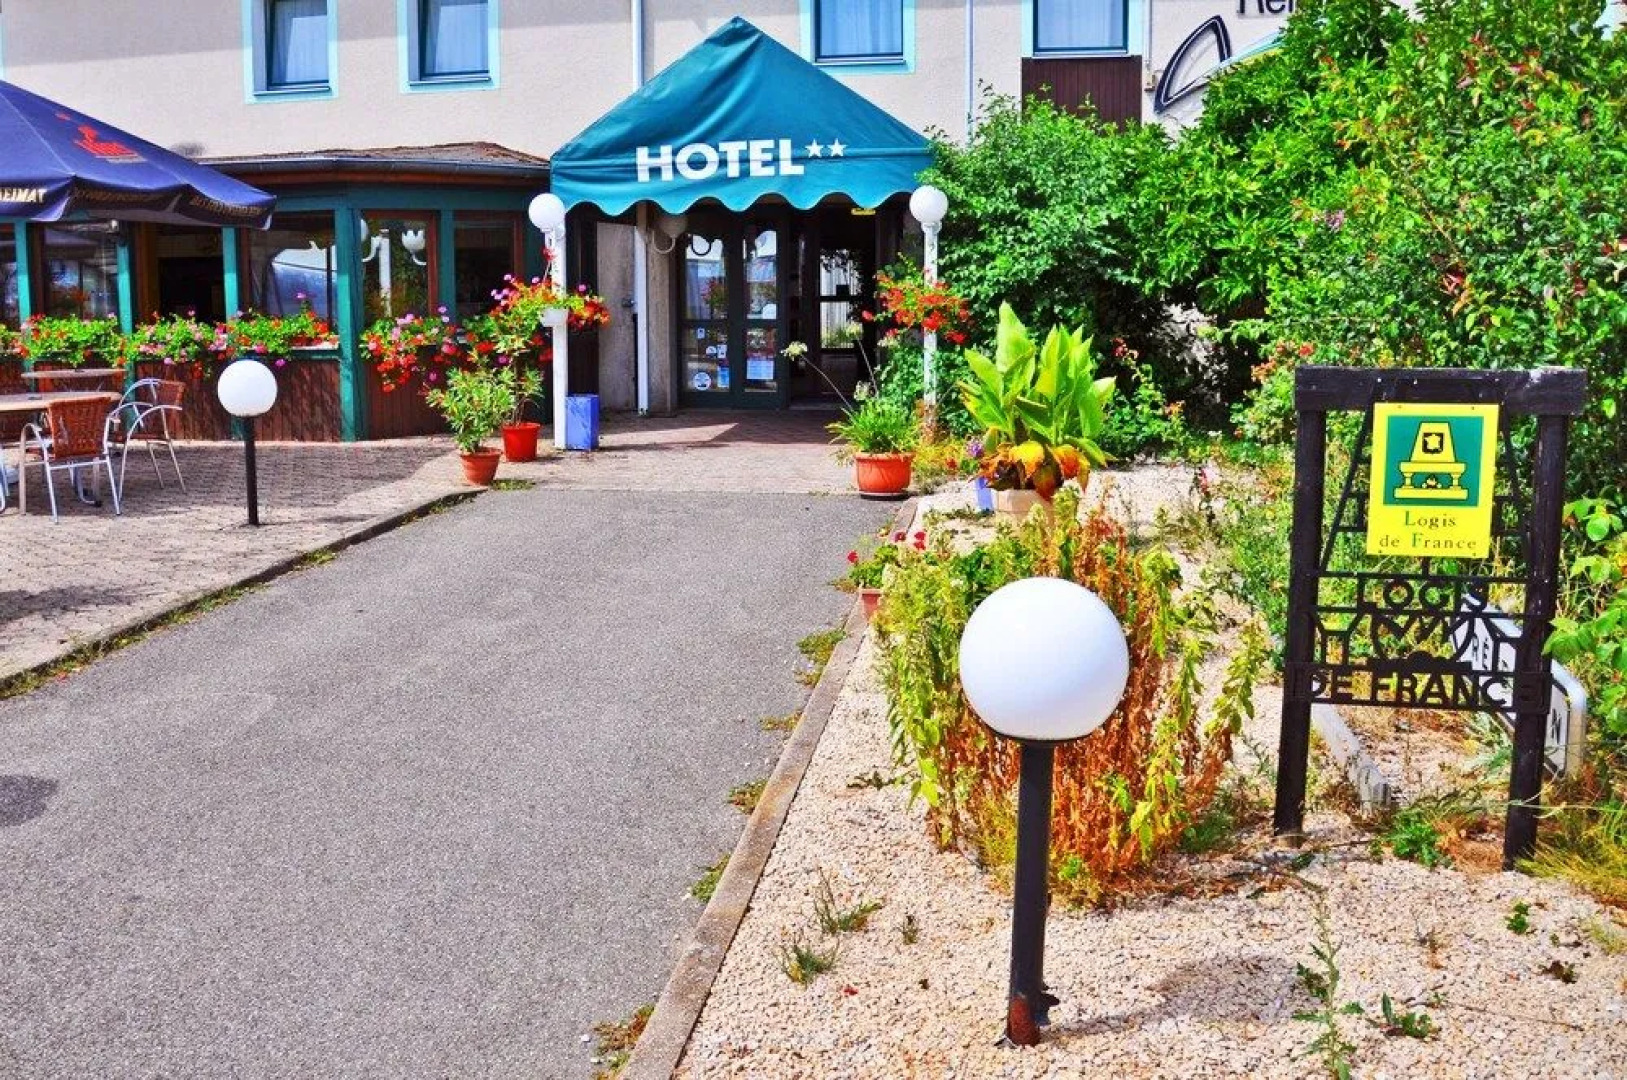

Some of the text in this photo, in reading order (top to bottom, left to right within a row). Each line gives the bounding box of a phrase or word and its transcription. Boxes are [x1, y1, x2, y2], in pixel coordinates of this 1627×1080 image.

[635, 138, 805, 183] HOTEL
[0, 187, 48, 204] EIMAT
[1404, 510, 1457, 530] Logis
[1379, 532, 1477, 549] de France
